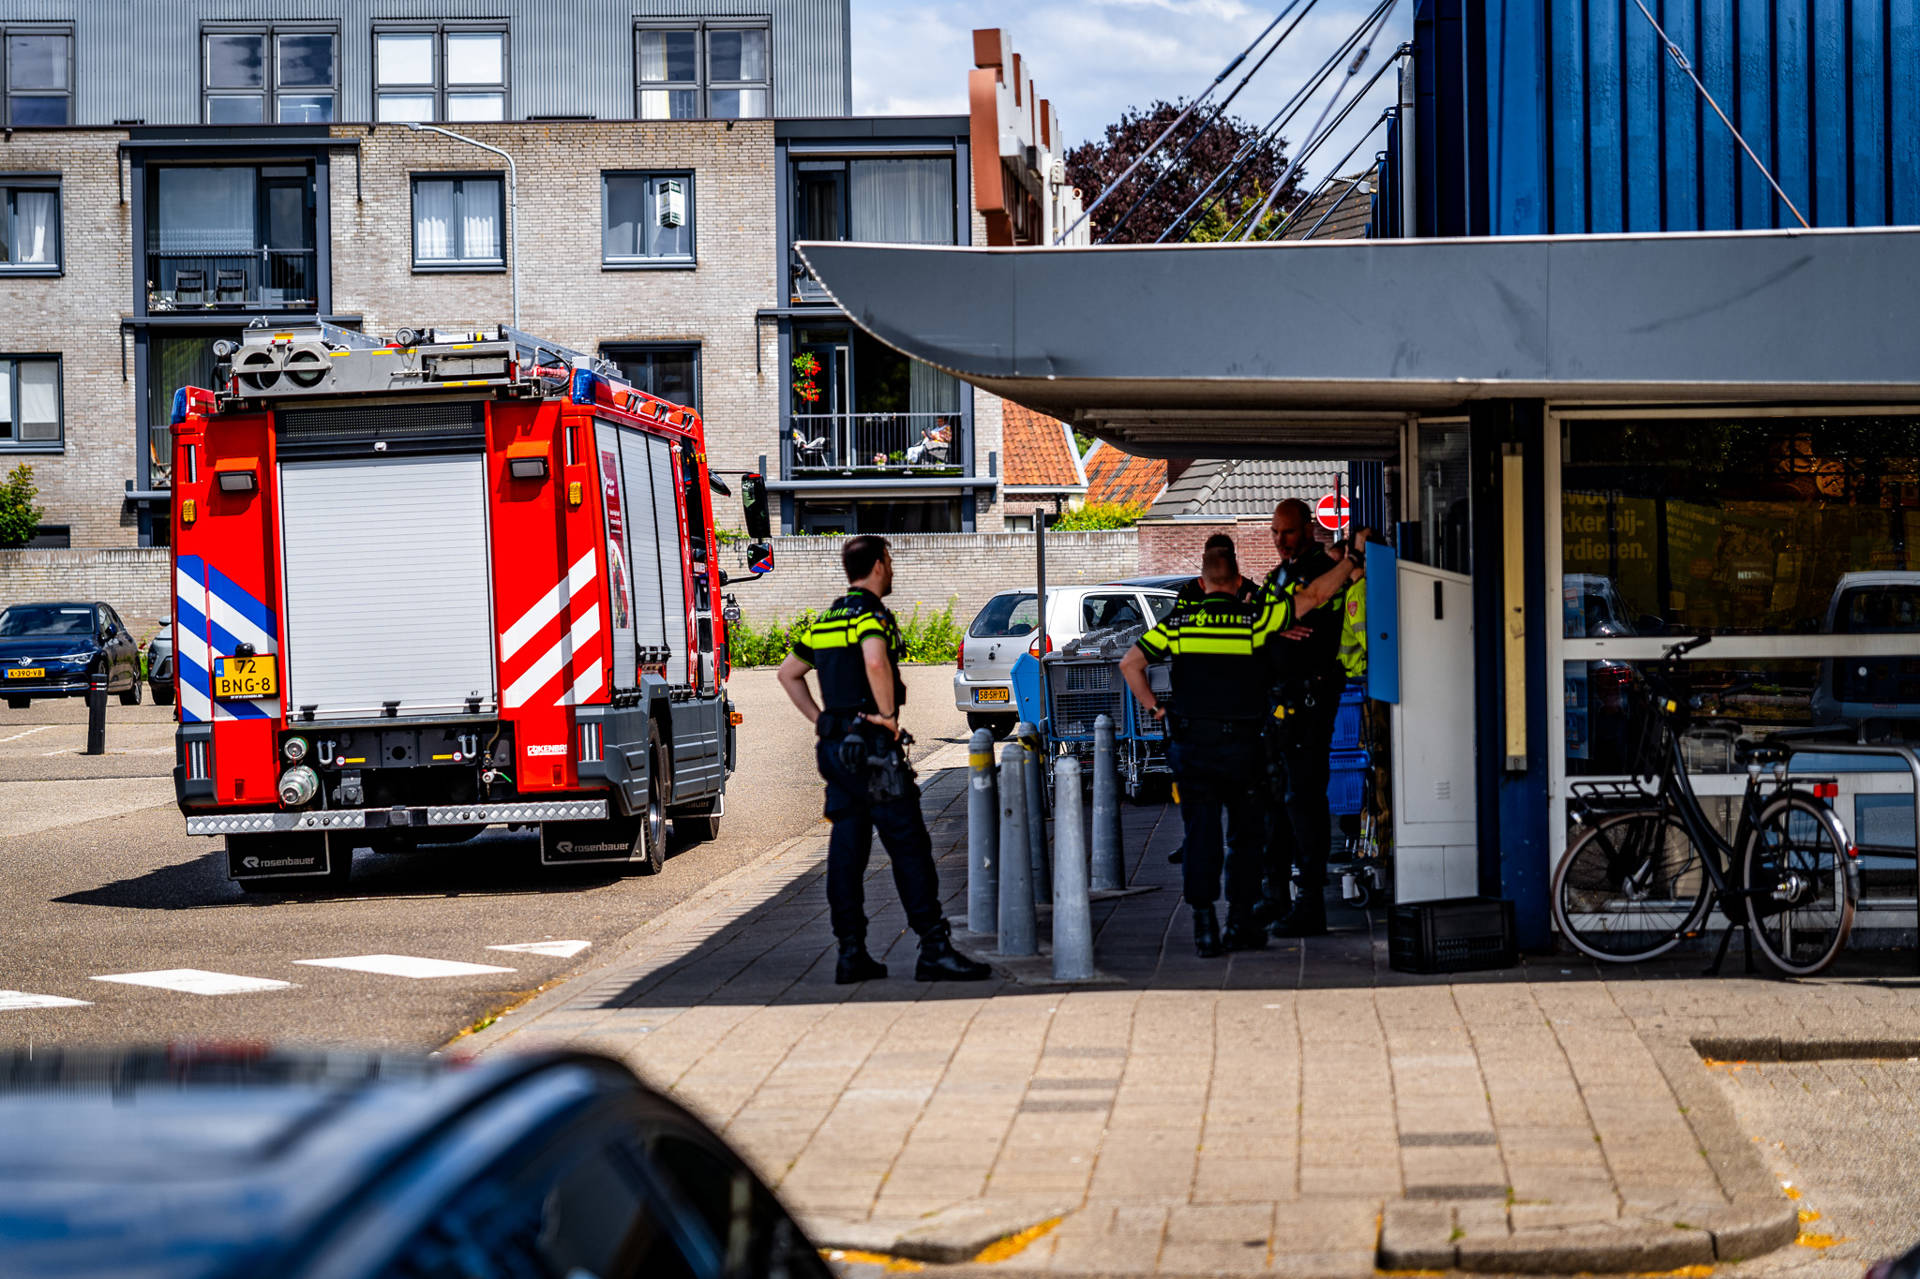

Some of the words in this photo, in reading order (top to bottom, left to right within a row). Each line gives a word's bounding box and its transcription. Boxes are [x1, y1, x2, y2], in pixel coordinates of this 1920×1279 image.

[1188, 610, 1243, 626] POLITIE
[237, 659, 256, 674] 72
[222, 677, 271, 693] BNG-8
[574, 841, 629, 852] rosenbauer
[260, 856, 315, 868] rosenbauer
